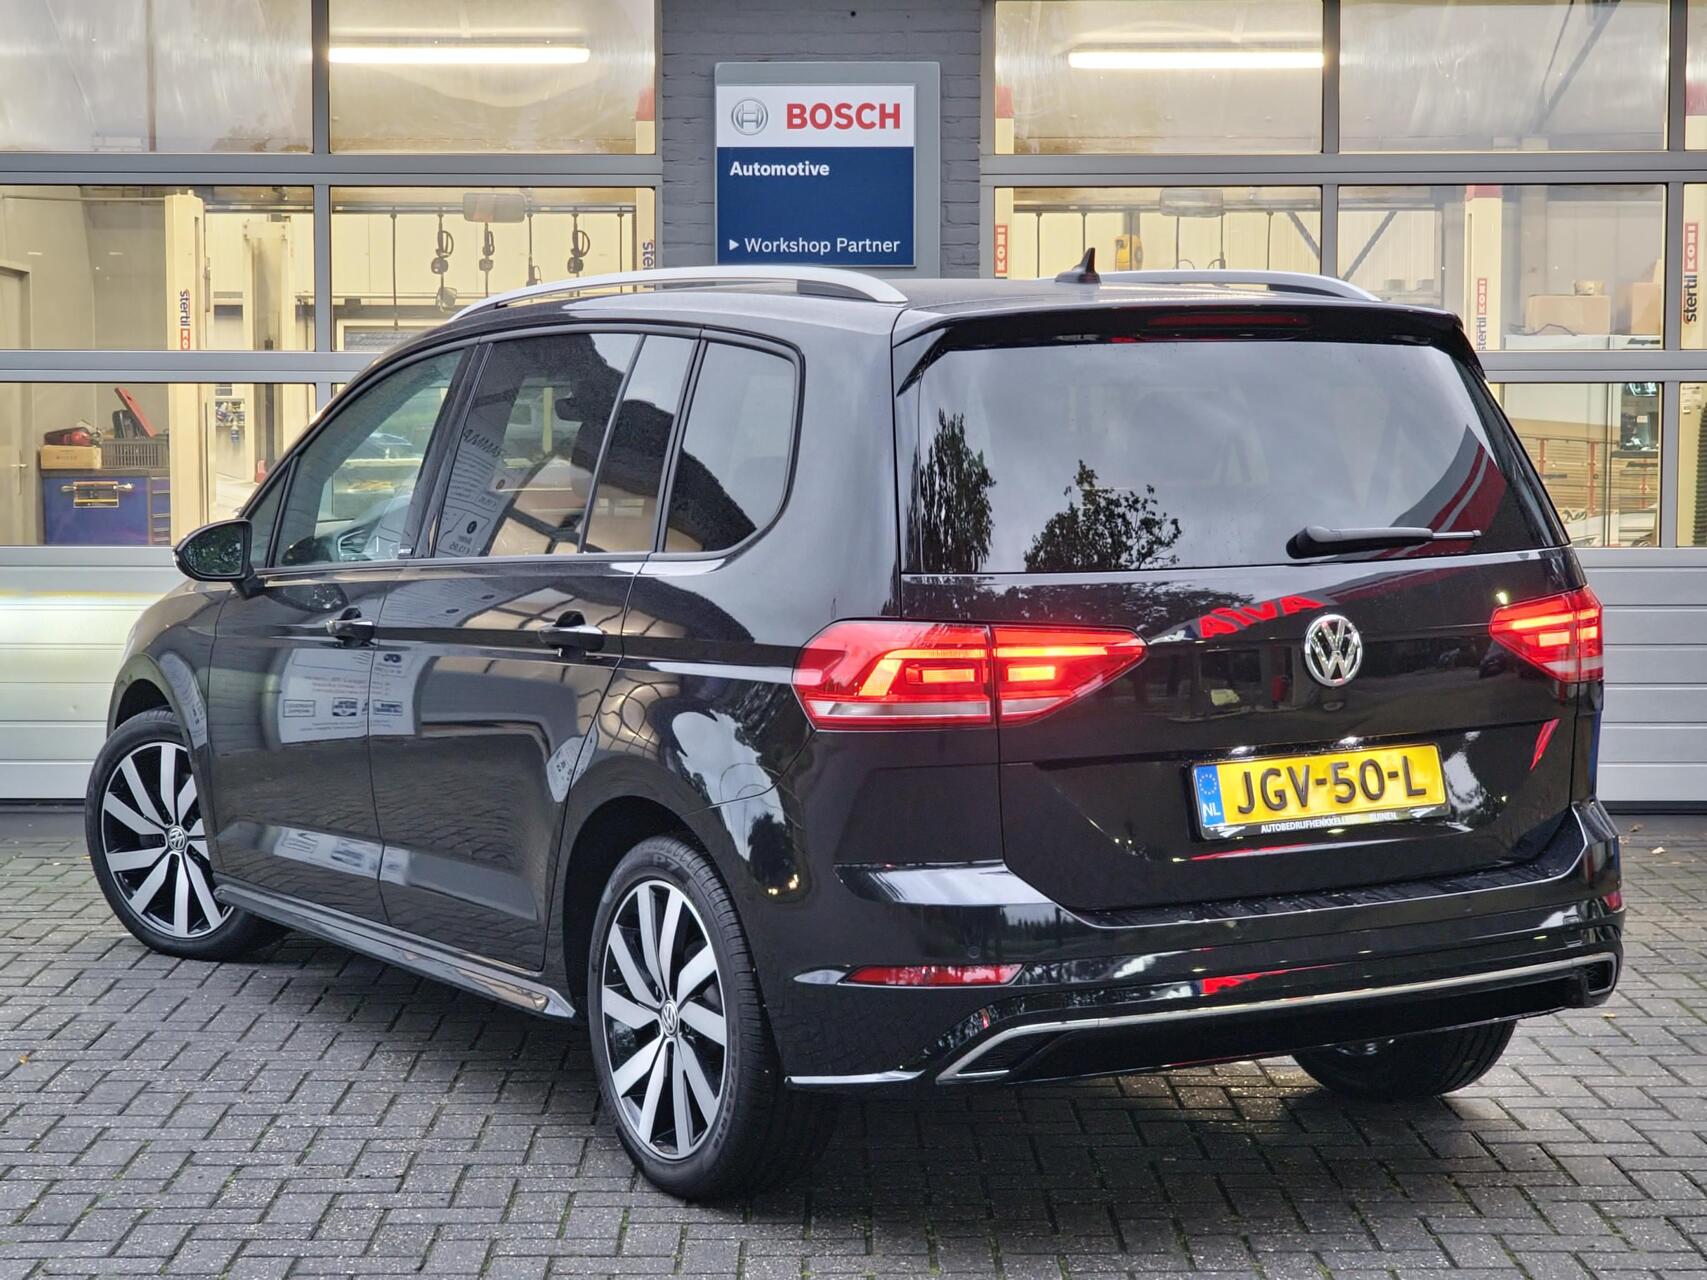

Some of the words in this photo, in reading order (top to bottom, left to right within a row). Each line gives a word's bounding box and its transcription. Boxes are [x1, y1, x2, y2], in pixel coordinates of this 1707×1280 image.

[786, 102, 901, 130] BOSCH
[730, 161, 830, 176] Automotive
[745, 237, 831, 255] Workshop
[837, 237, 901, 253] Partner
[996, 225, 1007, 273] KONI
[1686, 223, 1698, 271] KONI
[180, 289, 190, 327] stertil
[1684, 274, 1698, 323] stertil
[181, 329, 190, 350] KO
[1237, 755, 1427, 815] JGV-50-L
[1202, 802, 1221, 817] NL
